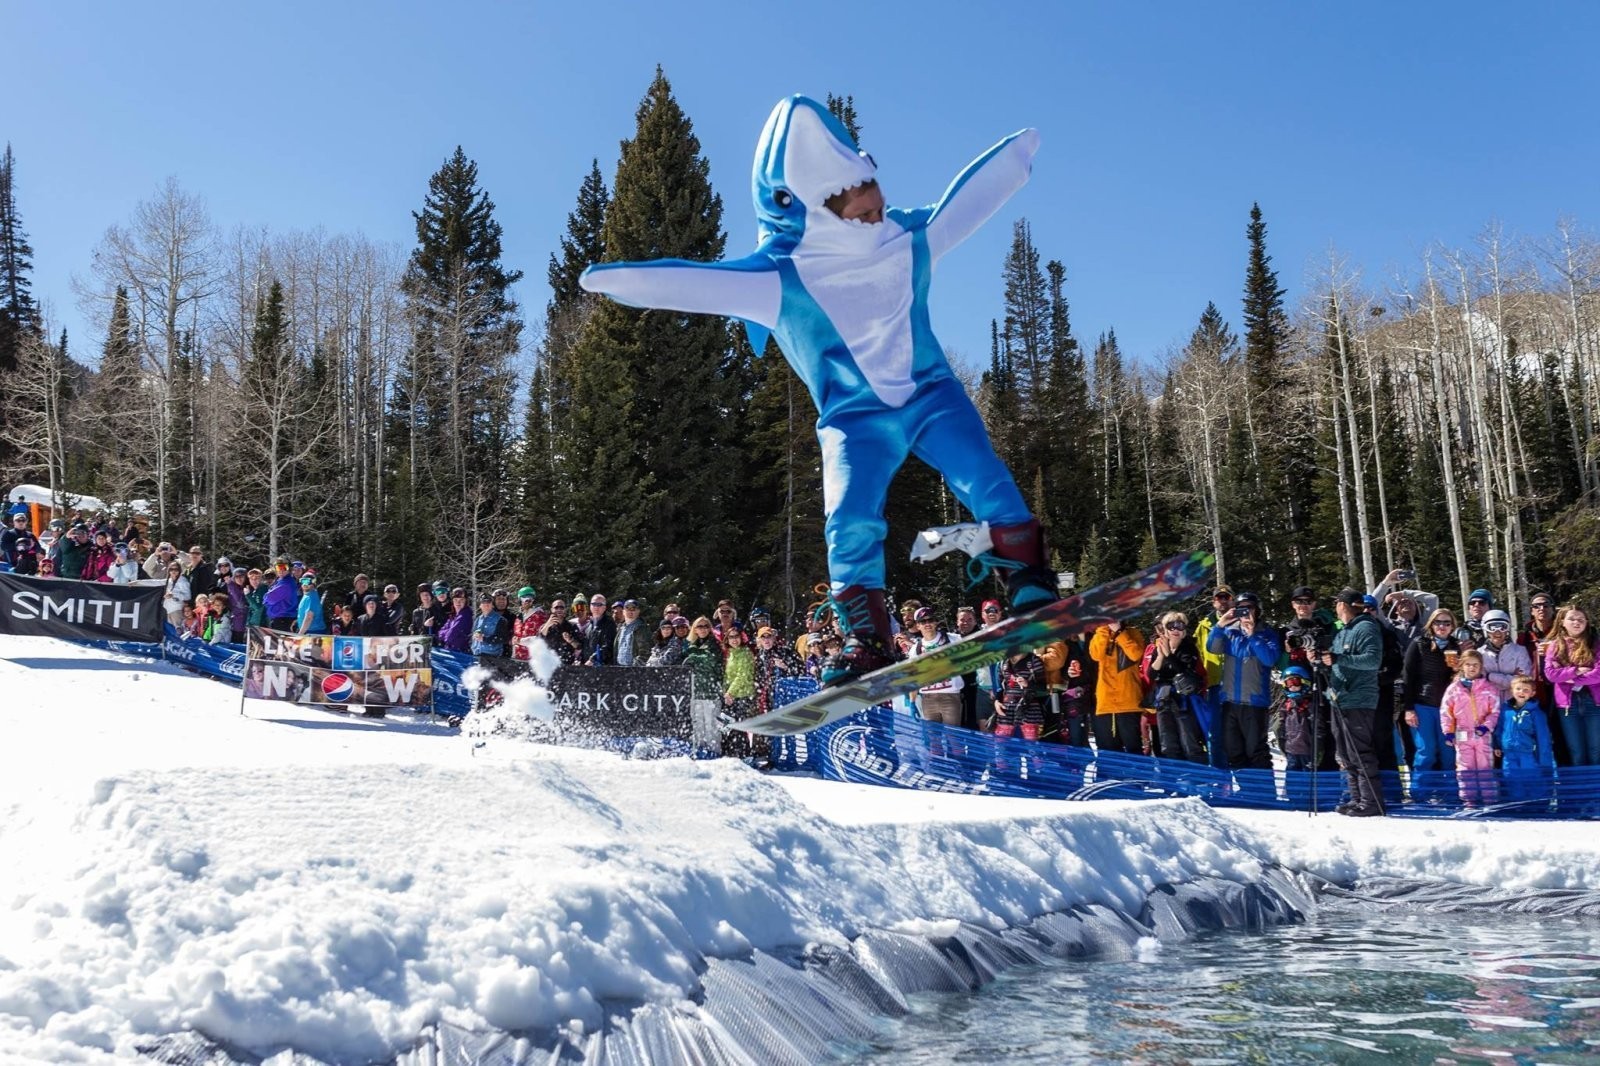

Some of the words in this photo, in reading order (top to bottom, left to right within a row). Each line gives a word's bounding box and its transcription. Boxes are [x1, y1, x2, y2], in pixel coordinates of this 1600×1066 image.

[11, 591, 140, 629] SMITH
[263, 635, 312, 662] LIVE
[377, 643, 424, 664] FOR
[623, 693, 685, 712] CITY
